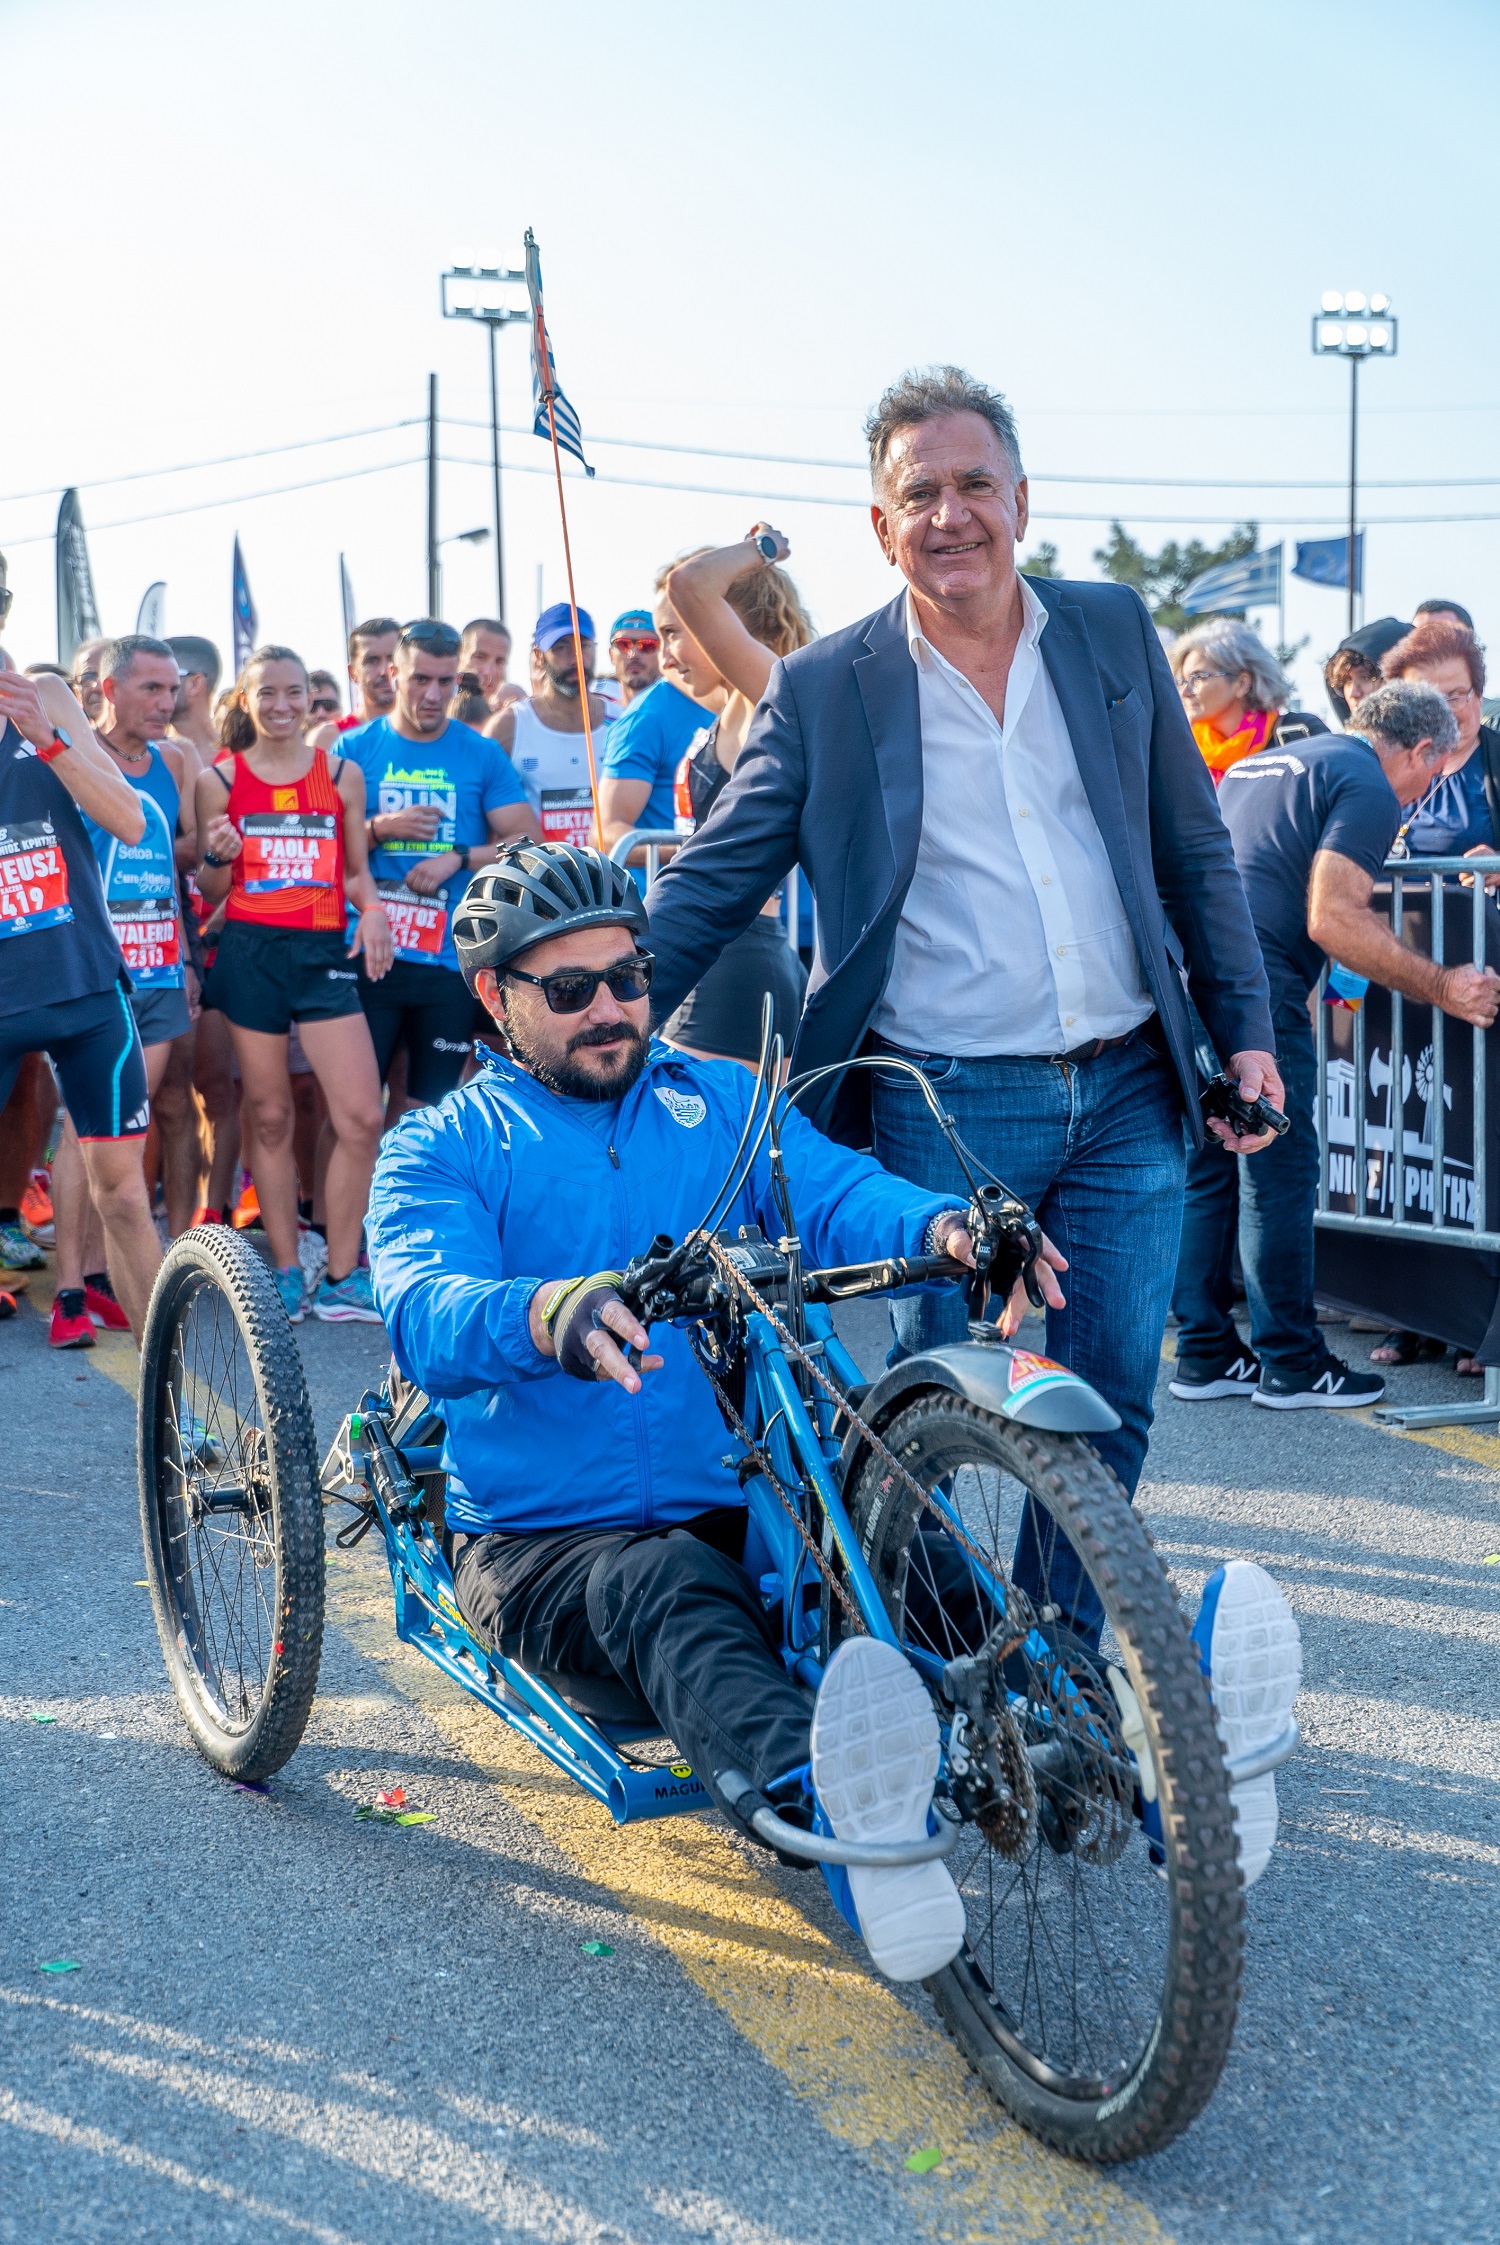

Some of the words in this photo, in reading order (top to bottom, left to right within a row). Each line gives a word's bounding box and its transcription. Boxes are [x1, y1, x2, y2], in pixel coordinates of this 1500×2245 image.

[379, 789, 457, 821] RUN
[543, 811, 593, 831] ΝΕΚΤΑ
[22, 834, 58, 852] ΚΡΗΤΗΣ
[261, 838, 320, 860] PAOLA
[268, 863, 313, 880] 2268
[0, 887, 44, 919] 419
[384, 902, 439, 931] ΩΡΓΟΣ
[114, 921, 174, 945] VALERIO
[865, 1497, 882, 1541] BADGER
